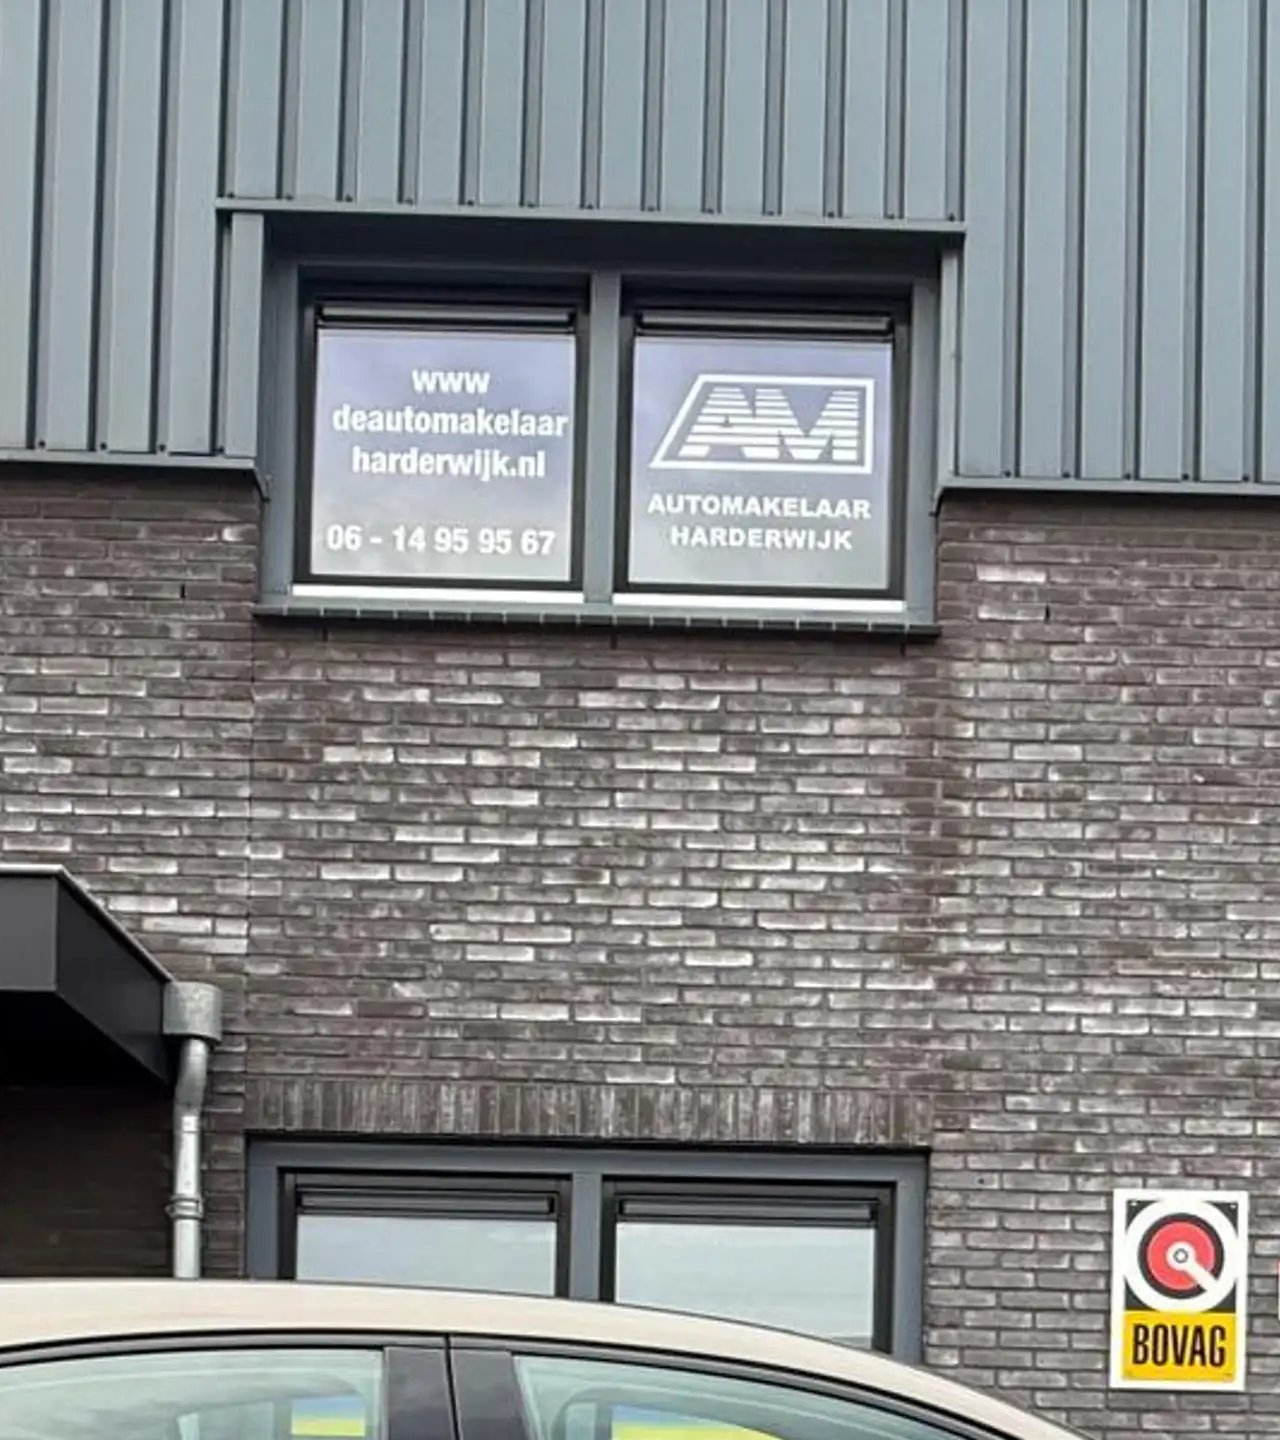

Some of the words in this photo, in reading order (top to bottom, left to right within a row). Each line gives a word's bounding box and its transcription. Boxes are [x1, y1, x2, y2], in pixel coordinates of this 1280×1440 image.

[411, 369, 491, 394] www
[332, 403, 568, 437] deautomakelaar
[352, 445, 546, 482] harderwijk.nl
[647, 493, 871, 520] AUTOMAKELAAR
[326, 524, 362, 551] 06
[392, 525, 426, 553] 14
[434, 527, 469, 554] 95
[478, 528, 512, 555] 95
[521, 529, 557, 556] 67
[670, 525, 853, 551] HARDERWIJK
[1132, 1323, 1226, 1368] BOVAG
